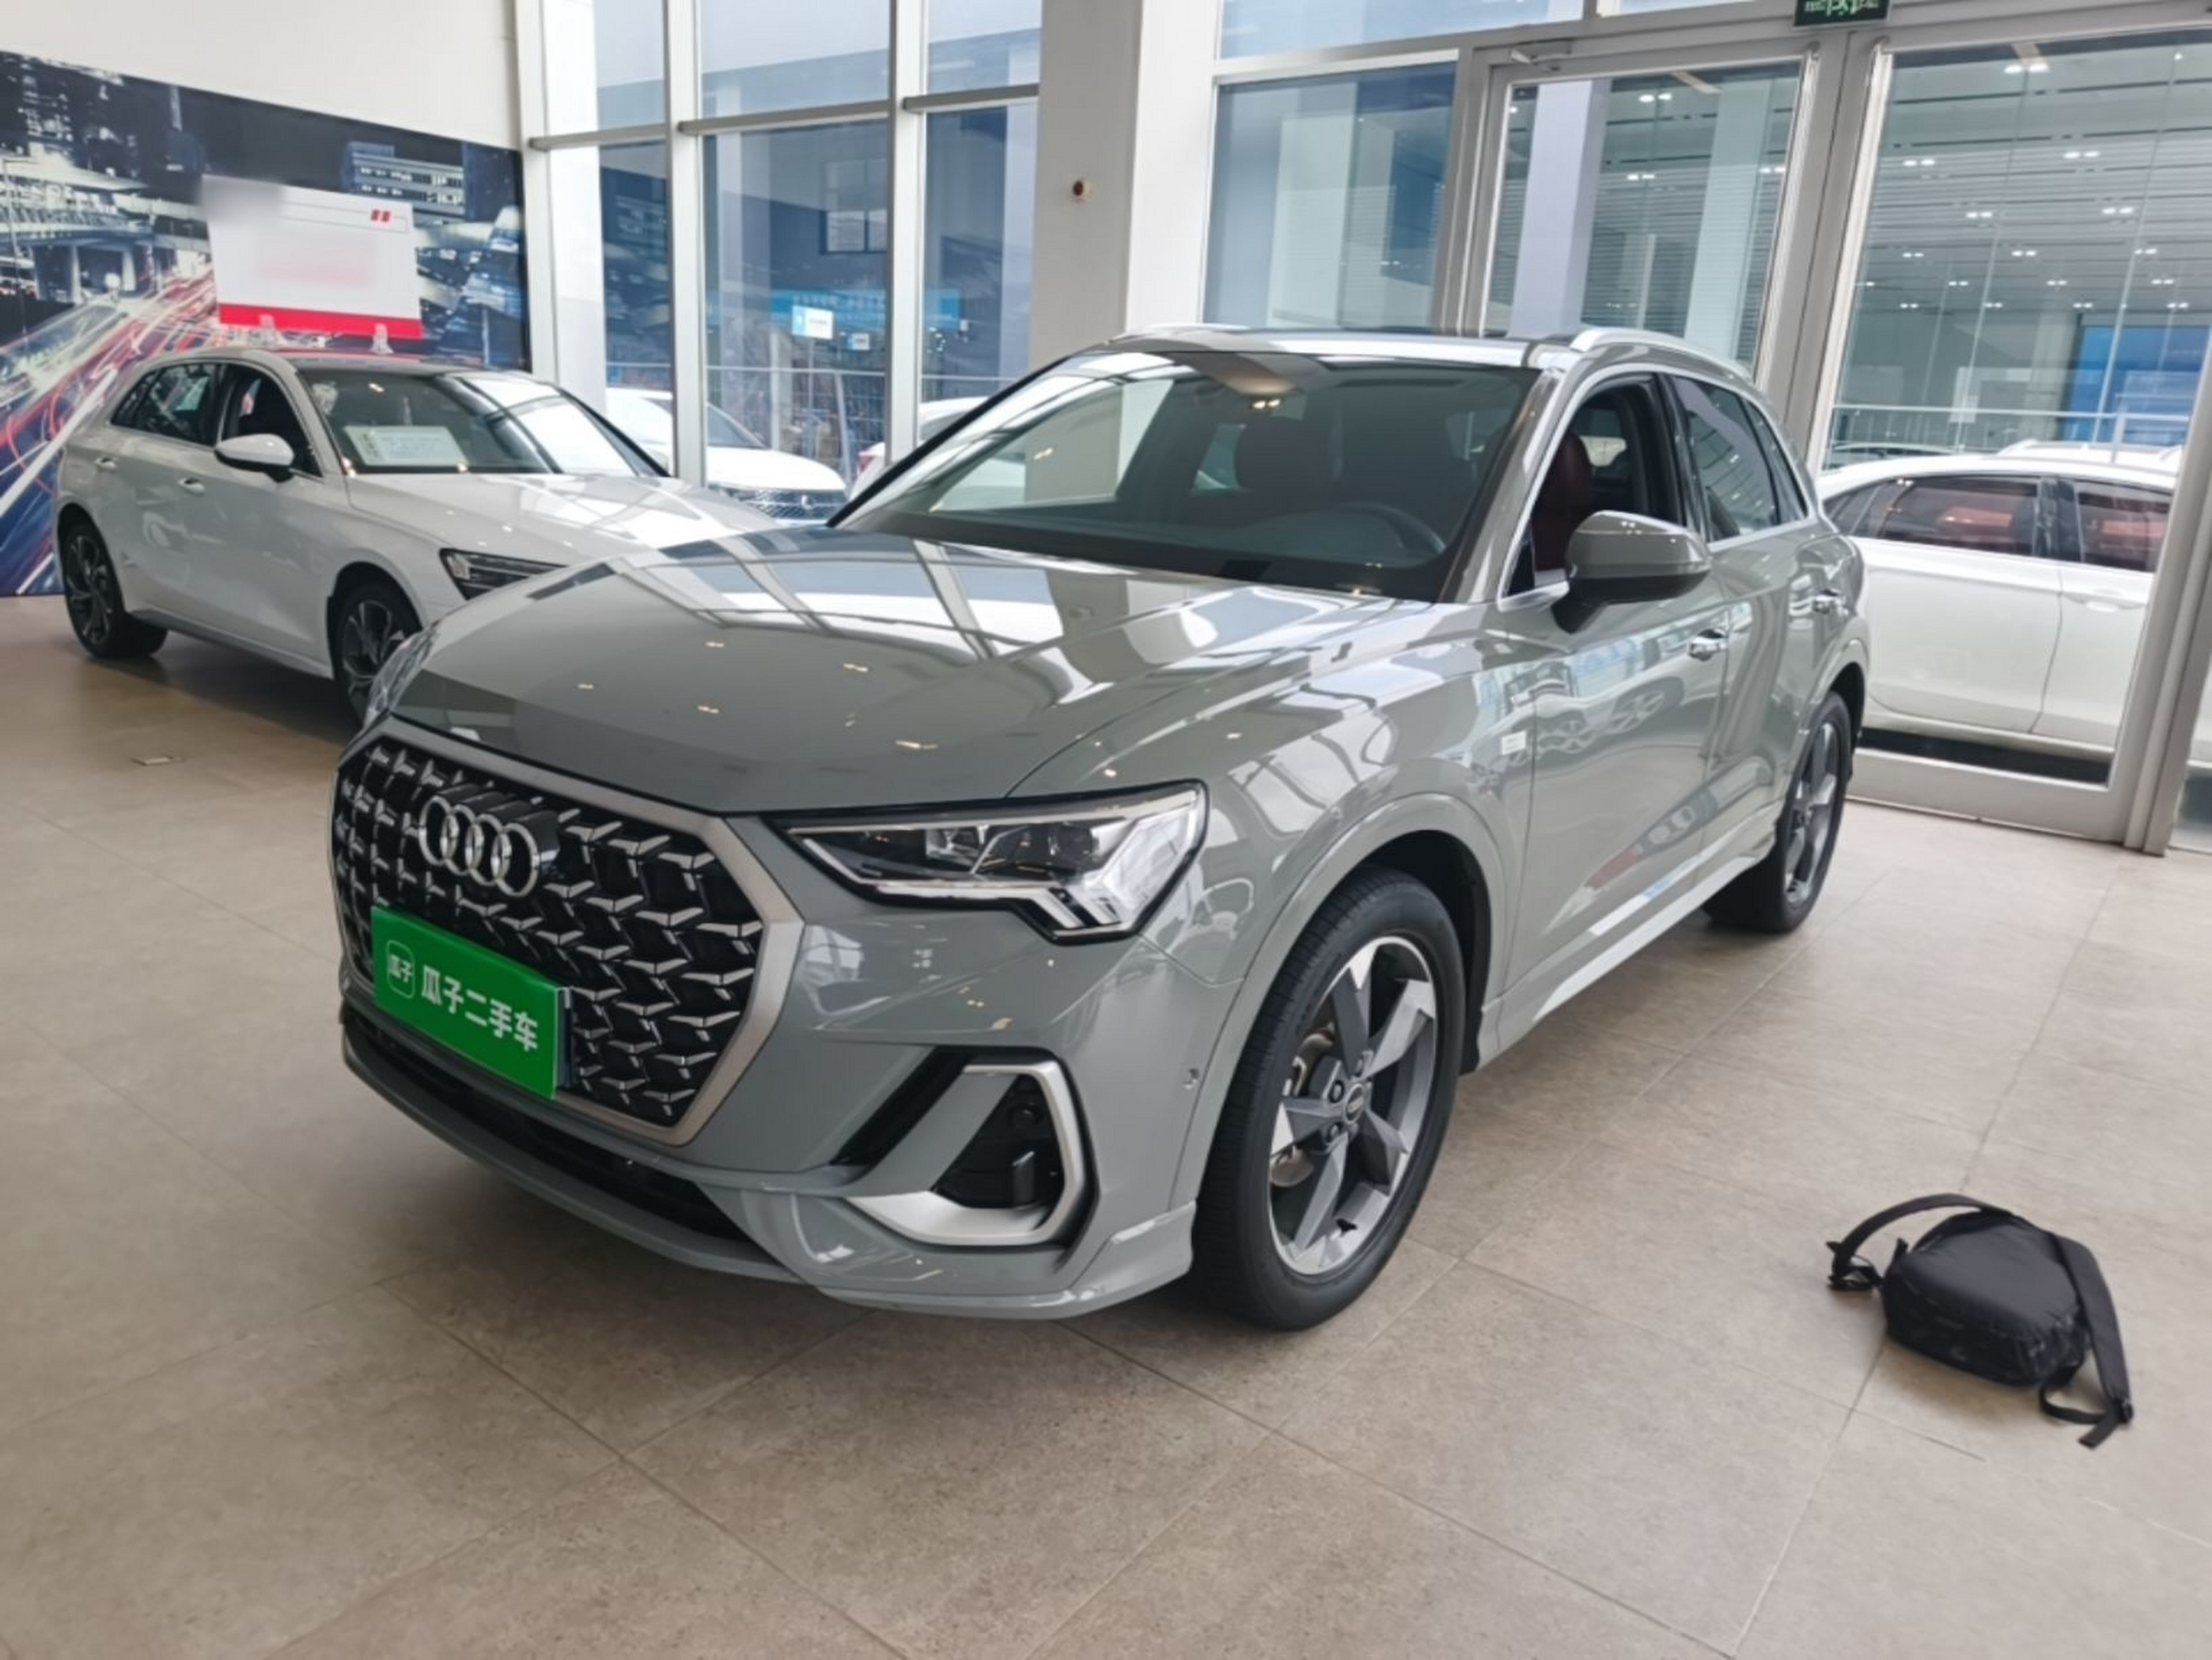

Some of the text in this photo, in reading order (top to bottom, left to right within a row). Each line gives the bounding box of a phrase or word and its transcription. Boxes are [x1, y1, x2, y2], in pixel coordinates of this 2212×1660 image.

[421, 965, 538, 1052] 瓜子二手车
